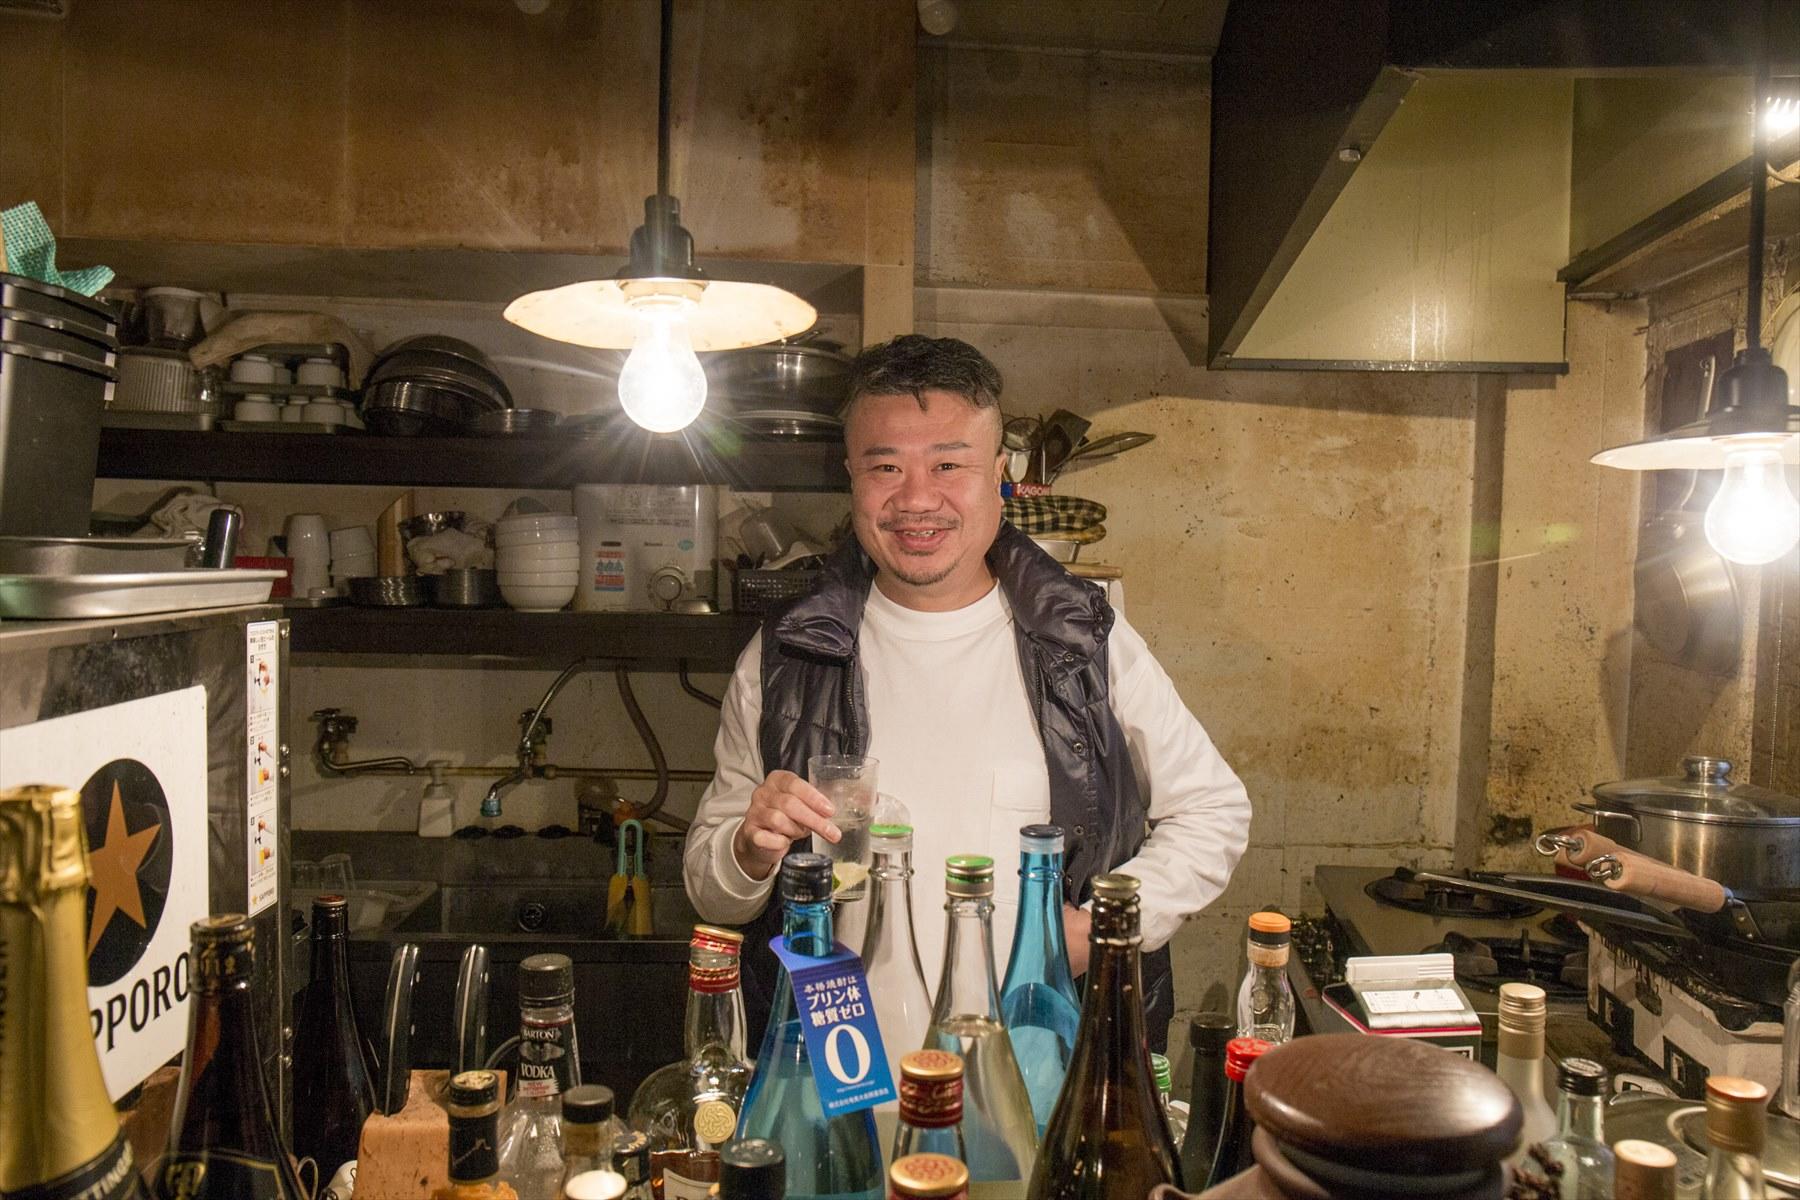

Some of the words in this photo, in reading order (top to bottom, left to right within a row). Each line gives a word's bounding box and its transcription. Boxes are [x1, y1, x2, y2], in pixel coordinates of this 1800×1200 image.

[1016, 484, 1050, 497] KAGOM
[90, 952, 190, 1053] PPORO
[806, 985, 862, 1011] プリン体
[810, 1002, 866, 1028] 糖質ゼロ
[825, 1023, 871, 1085] 0
[521, 1063, 556, 1079] VODKA
